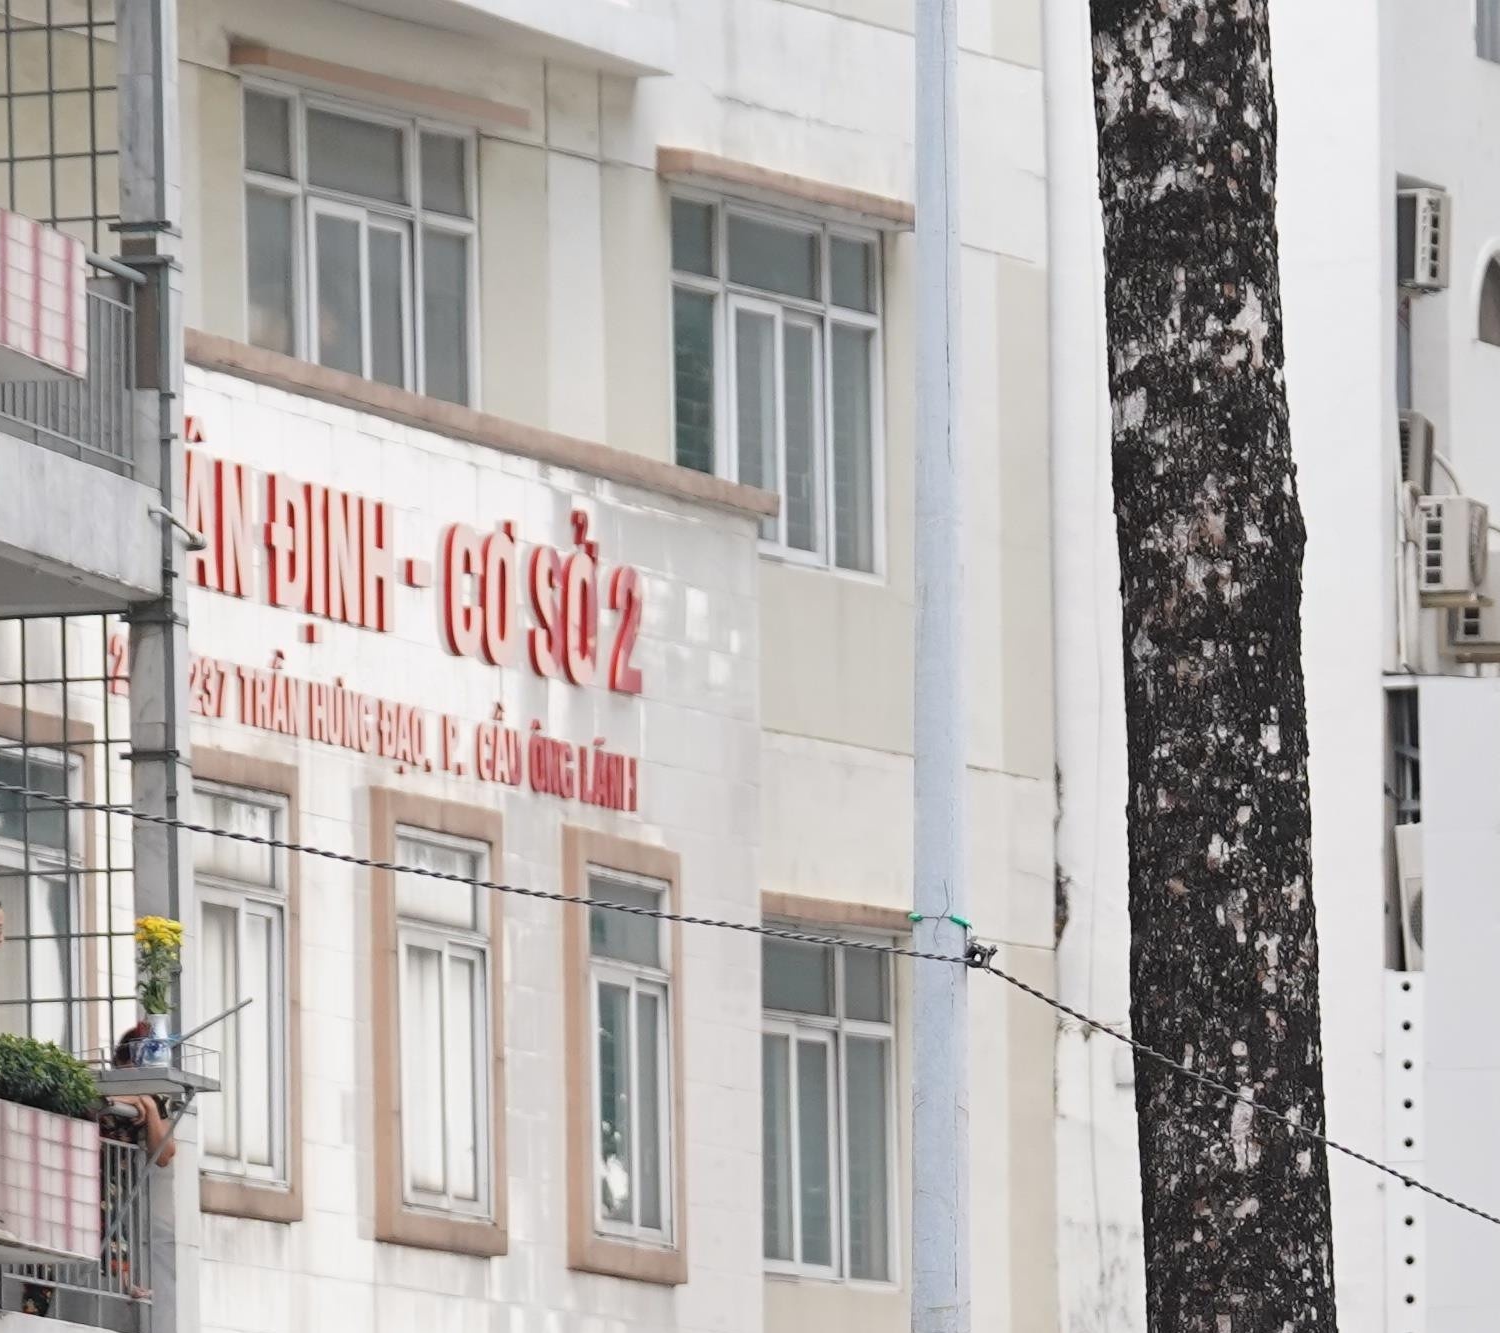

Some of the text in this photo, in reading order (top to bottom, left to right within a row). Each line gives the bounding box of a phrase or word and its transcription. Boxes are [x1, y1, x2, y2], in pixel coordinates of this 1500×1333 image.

[264, 470, 395, 646] ĐỊNH
[442, 519, 516, 667] CƠ
[528, 507, 599, 687] SỞ
[609, 565, 644, 696] 2
[236, 649, 300, 737] TRẦN
[307, 676, 372, 755] HƯNG
[440, 713, 468, 777] P.
[476, 701, 523, 787] CẦU
[529, 718, 574, 801] ÔNG
[579, 736, 639, 813] LÃNH
